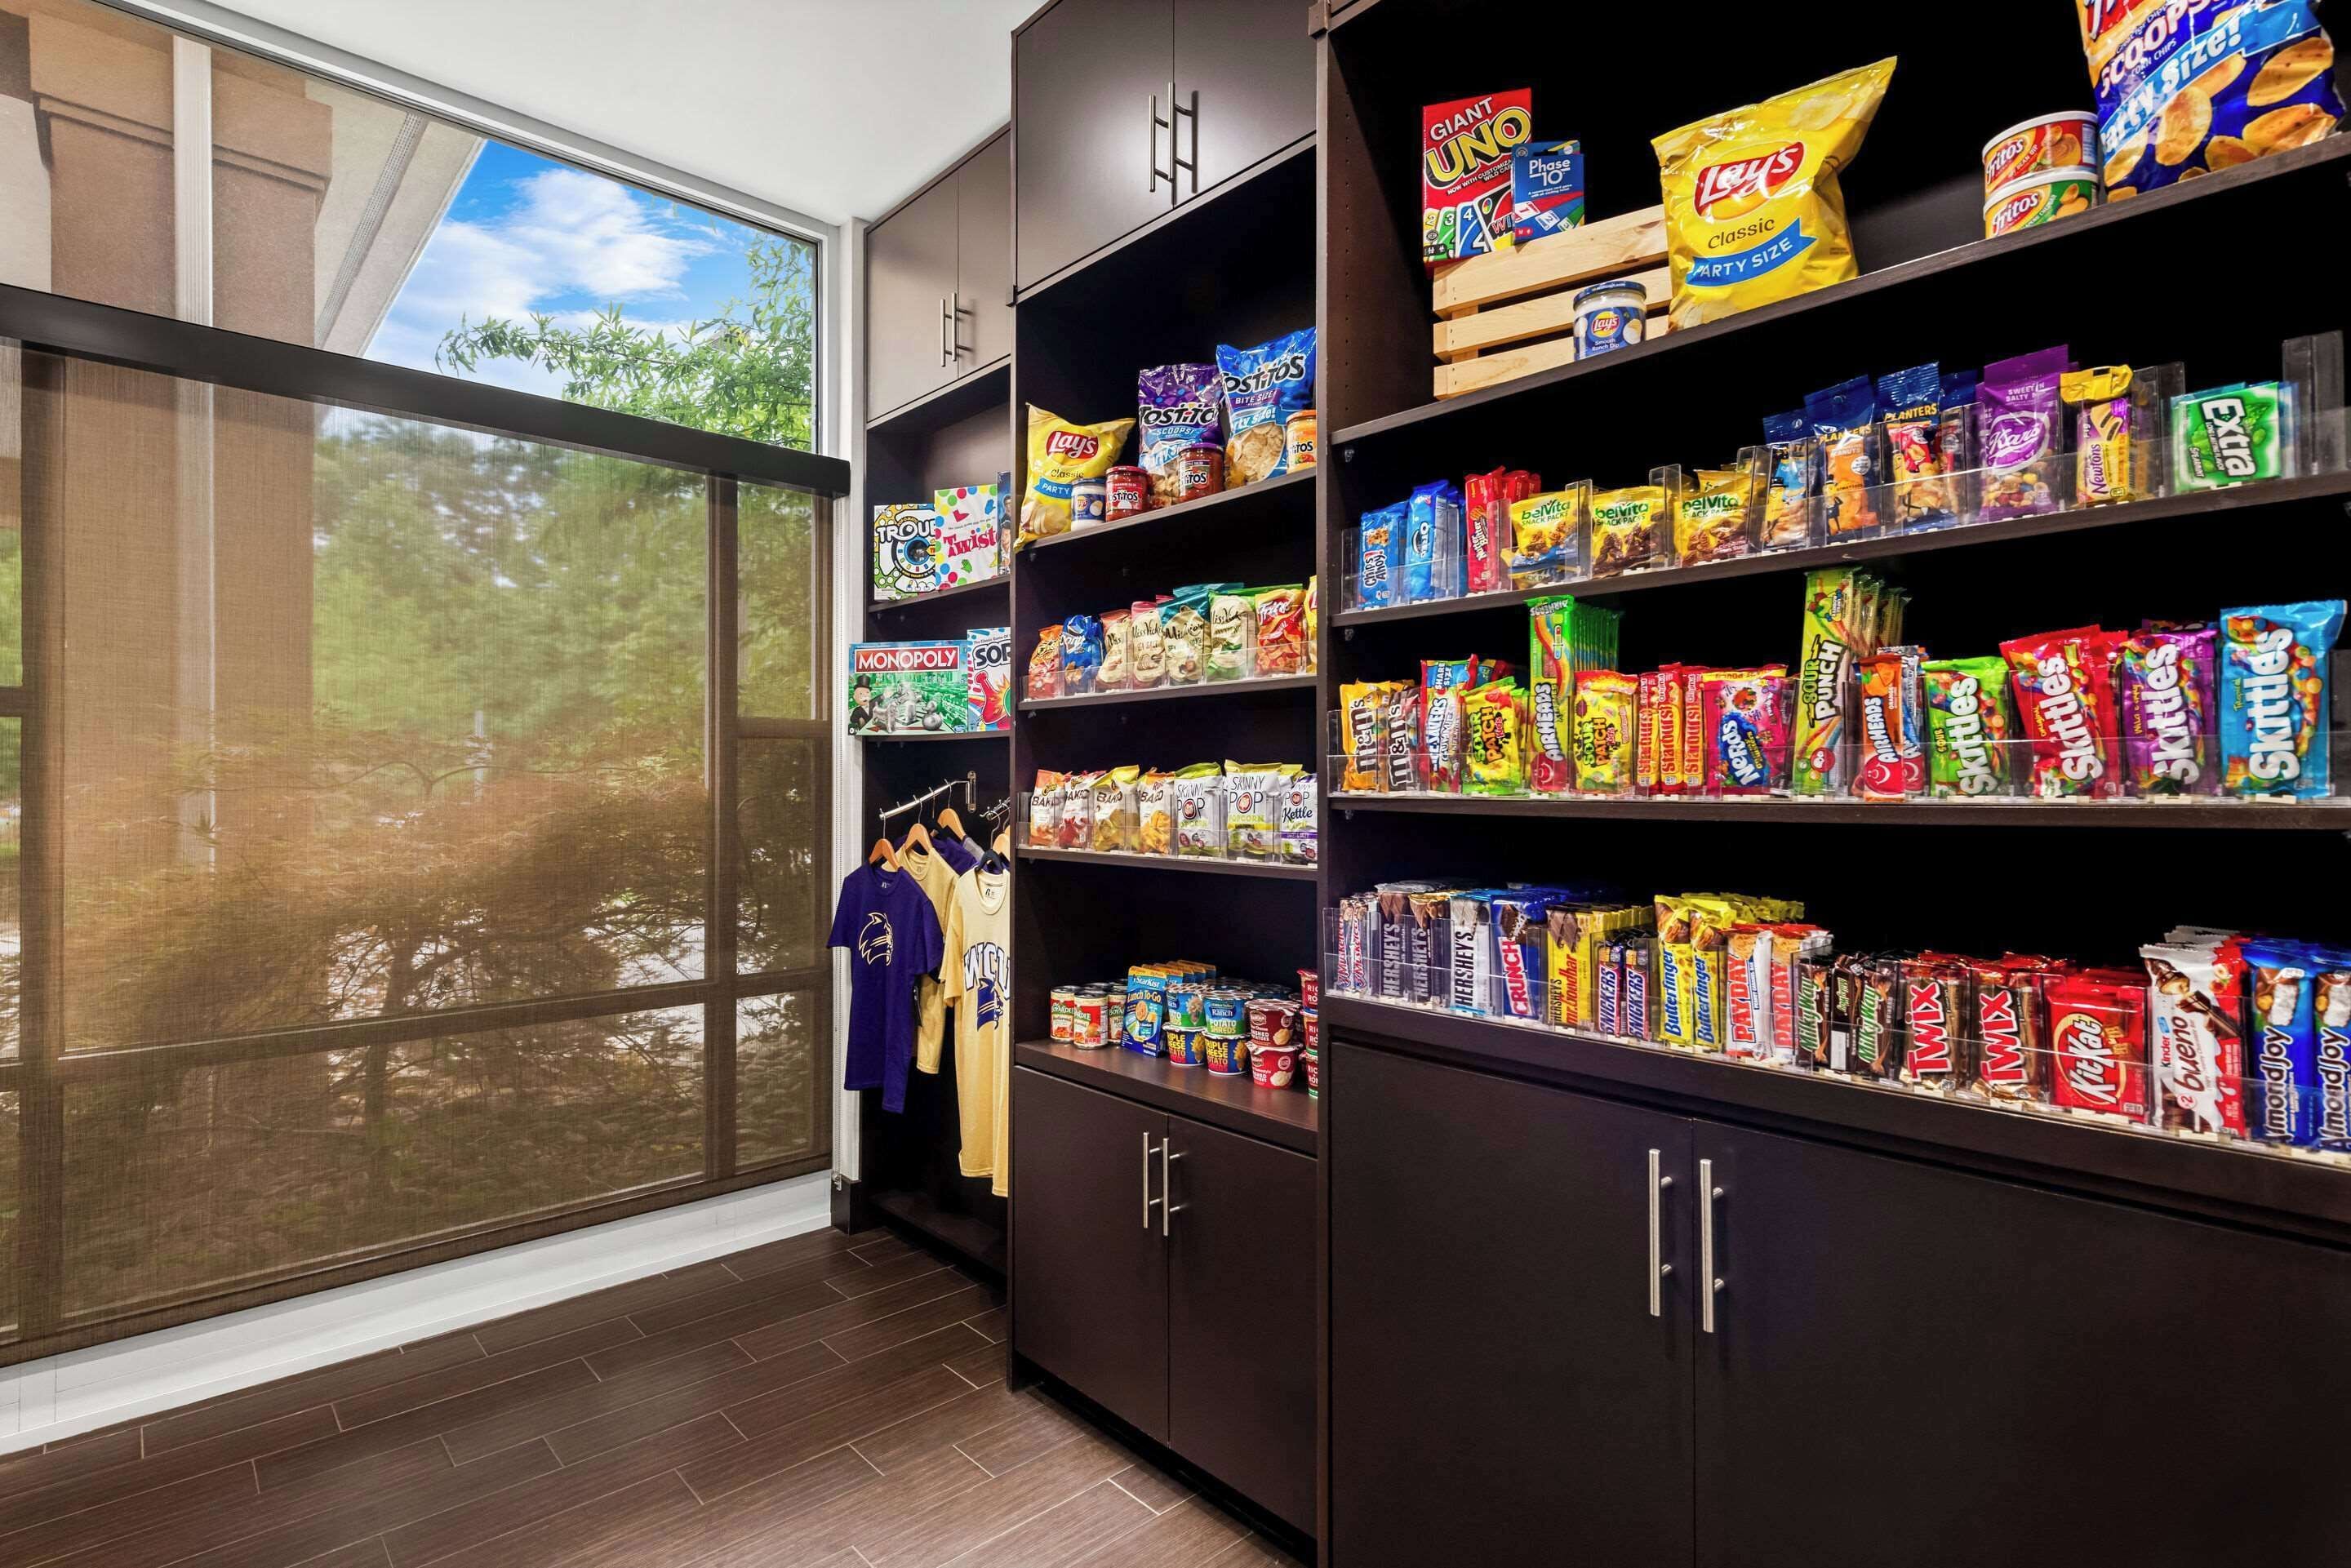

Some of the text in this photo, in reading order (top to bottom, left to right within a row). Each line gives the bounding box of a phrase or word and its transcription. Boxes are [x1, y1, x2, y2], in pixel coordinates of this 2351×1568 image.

[2153, 38, 2177, 61] CHIPS
[1430, 97, 1493, 141] GIANT
[1426, 107, 1531, 187] UNO
[1986, 138, 2024, 184] Fritos
[1447, 159, 1513, 196] NOW WITH CUSTOMIZA
[1529, 158, 1571, 175] Phase
[1542, 170, 1563, 186] 10
[1699, 145, 1798, 207] Lay's
[1445, 212, 1455, 226] 3
[1464, 208, 1473, 220] 4
[1992, 193, 2038, 236] Fritos
[1708, 218, 1775, 249] Classic
[1693, 238, 1793, 278] PARTY SIZE
[1224, 354, 1304, 393] OSTITOS
[1235, 396, 1255, 405] BITE
[2006, 393, 2029, 402] SALTY
[2008, 384, 2034, 395] SWEET
[1884, 402, 1937, 421] PLANTERS
[1049, 432, 1096, 459] Lay's
[1157, 427, 1194, 435] SCOOPS!
[2202, 398, 2256, 476] Extra
[1051, 469, 1084, 478] Classic
[2089, 444, 2109, 495] Newtons
[1042, 482, 1070, 495] PARTY
[1682, 495, 1739, 513] belVita
[1522, 500, 1571, 520] belVita
[1522, 511, 1569, 526] SNACK PACKS
[1595, 502, 1649, 519] belVita
[943, 526, 997, 557] Twist
[1471, 535, 1487, 560] Nutter
[1474, 521, 1488, 544] Butter
[1364, 557, 1376, 587] Chips
[1374, 550, 1386, 581] Ahoy!
[858, 649, 957, 670] MONOPOLY
[976, 642, 1011, 667] SOR
[1435, 662, 1446, 690] SHARE
[1444, 667, 1452, 686] SIZE
[1658, 673, 1666, 702] Original
[1802, 660, 1820, 704] SOUR
[1815, 640, 1843, 720] PUNCH
[2037, 653, 2103, 780] Skittles
[2141, 643, 2200, 784] Skittles
[2242, 628, 2300, 780] Skittles
[1470, 712, 1486, 763] SOUR
[1480, 707, 1504, 762] PATCH
[1535, 683, 1564, 762] AIRHEADS
[1864, 697, 1900, 763] AIRHEADS
[1945, 677, 1998, 795] Skittles
[1582, 720, 1594, 766] SOUR
[1592, 717, 1611, 766] PATCH
[1935, 728, 1947, 753] SOUR
[1233, 776, 1266, 791] SKINNY
[1285, 792, 1309, 806] POP
[1177, 797, 1205, 820] POP
[1229, 791, 1264, 814] POP
[1282, 806, 1313, 824] Kettle
[963, 942, 1010, 1001] WCU
[1384, 923, 1401, 996] HERSHEY'S
[1411, 927, 1429, 997] HERSHEY'S
[1455, 931, 1474, 1006] HERSHEY'S
[1136, 976, 1159, 988] StarKist
[1502, 940, 1529, 1015] CRUNCH
[1663, 949, 1682, 1037] Butterfinger
[1127, 989, 1143, 1003] Lunch
[1308, 995, 1318, 1003] RO
[1550, 979, 1562, 1023] HERSHEY'S
[1599, 966, 1615, 1034] SNICKERS
[1628, 970, 1643, 1039] SNICKERS
[1695, 955, 1715, 1044] Butterfinger
[1728, 954, 1755, 1042] PAYDAY
[1771, 961, 1793, 1048] PAYDAY
[1211, 1008, 1233, 1017] Ranch
[2068, 1019, 2118, 1104] KitKat
[2160, 1036, 2171, 1068] Kinder
[2171, 1016, 2205, 1092] bueno
[1308, 1064, 1318, 1074] RIC
